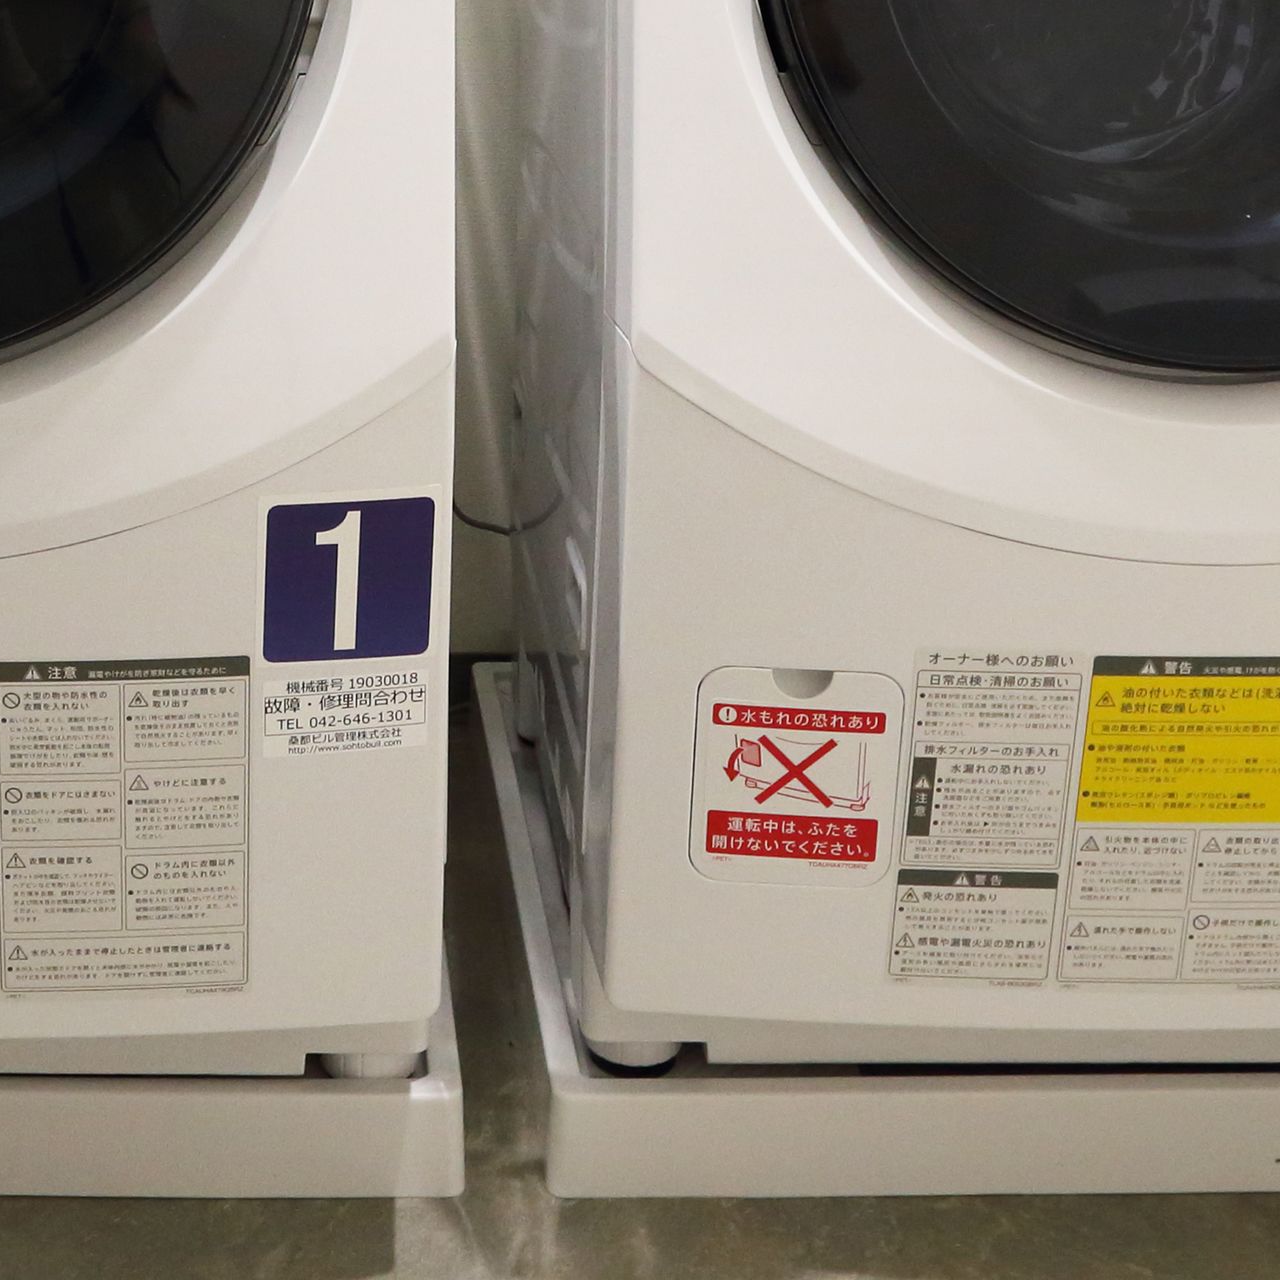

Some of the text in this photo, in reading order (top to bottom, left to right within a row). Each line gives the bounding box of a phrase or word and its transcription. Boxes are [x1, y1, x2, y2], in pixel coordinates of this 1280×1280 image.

[315, 509, 362, 651] 1
[928, 652, 1074, 668] オーナー様へのお願い
[47, 666, 78, 680] 注意
[1164, 660, 1193, 675] 警告
[286, 672, 419, 694] 機械番号 19030018
[929, 674, 1070, 688] 日常点検・清掃のお願い
[23, 692, 108, 700] 大型の物や防水性の
[151, 686, 236, 698] 乾燥後は衣類を早く
[23, 703, 90, 711] 衣類を入れない
[151, 699, 189, 709] 取り出す
[264, 688, 425, 715] 故障・修理問合わせ
[1120, 702, 1226, 715] 絶対に乾燥しない
[276, 709, 413, 731] TEL 042-646-1301
[740, 709, 880, 730] 水もれの恐れあり
[287, 726, 403, 747] 桑都ビル管理株式会社
[923, 744, 1060, 758] 排水フィルターのお手入れ
[950, 763, 1047, 776] 水漏れの恐れあり
[153, 778, 227, 788] やけどに注意する
[25, 789, 117, 801] 衣類をドアにはさまない
[727, 817, 858, 838] 運転中は、ふたを
[711, 834, 870, 858] 開けないでください。
[28, 857, 93, 866] 衣類を確認する
[154, 858, 236, 870] ドラム内に衣類以外
[153, 870, 227, 880] のものを入れない
[922, 891, 998, 903] 発火の恐れあり
